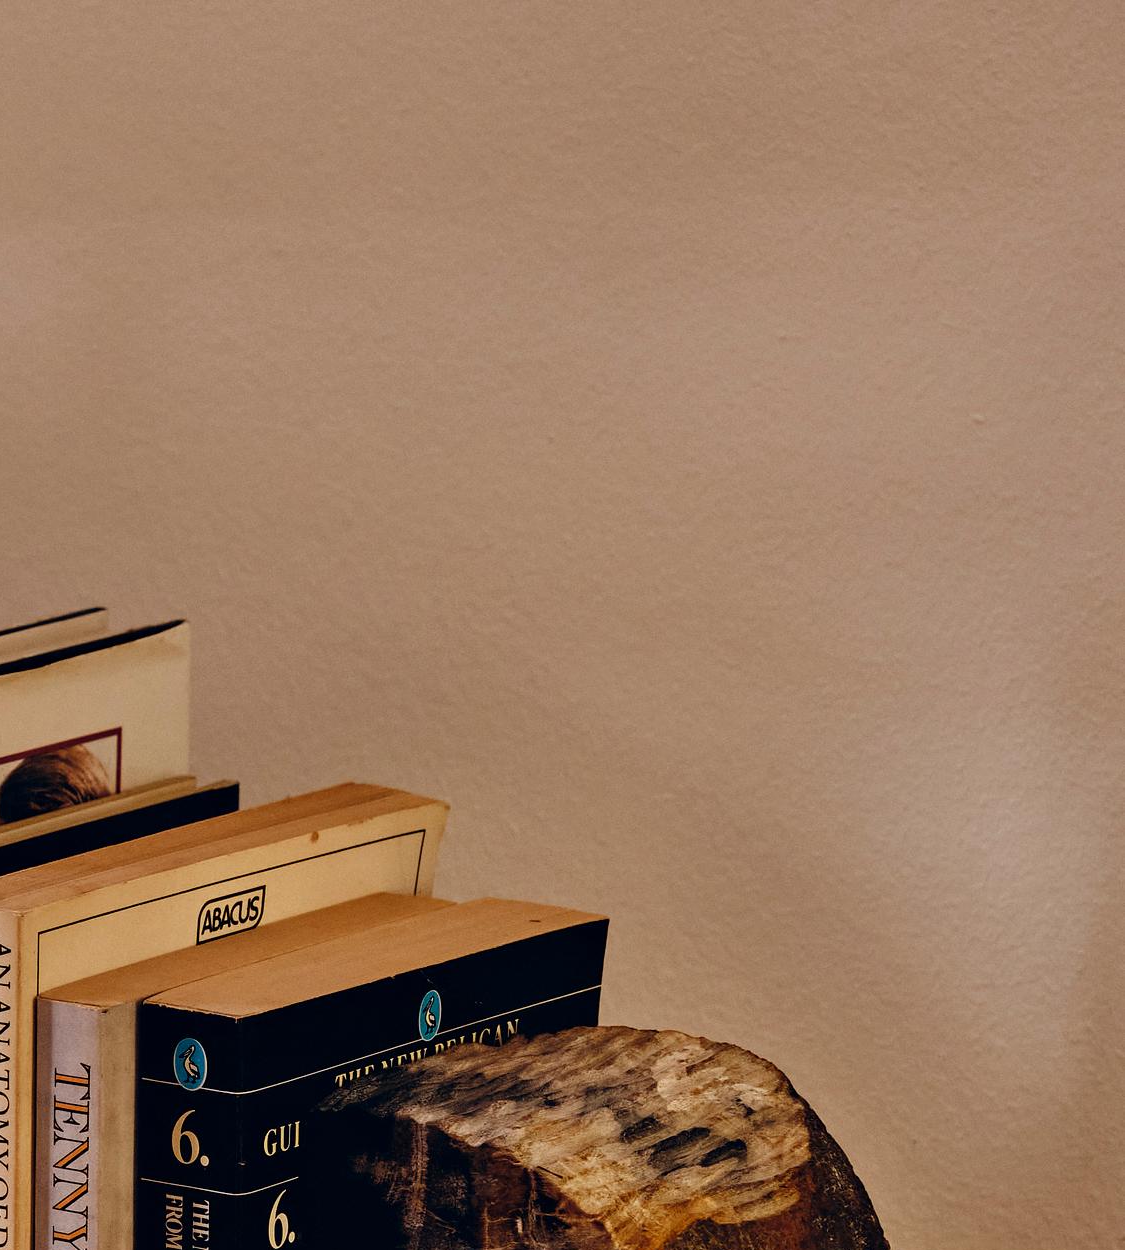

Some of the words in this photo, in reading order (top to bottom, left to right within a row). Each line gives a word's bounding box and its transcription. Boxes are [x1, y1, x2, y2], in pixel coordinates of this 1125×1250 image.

[201, 895, 261, 934] ABACUS
[172, 1110, 210, 1167] 6.
[263, 1120, 300, 1157] GUI
[165, 1193, 183, 1250] FROM
[192, 1199, 210, 1242] THE
[268, 1188, 296, 1250] 6.
